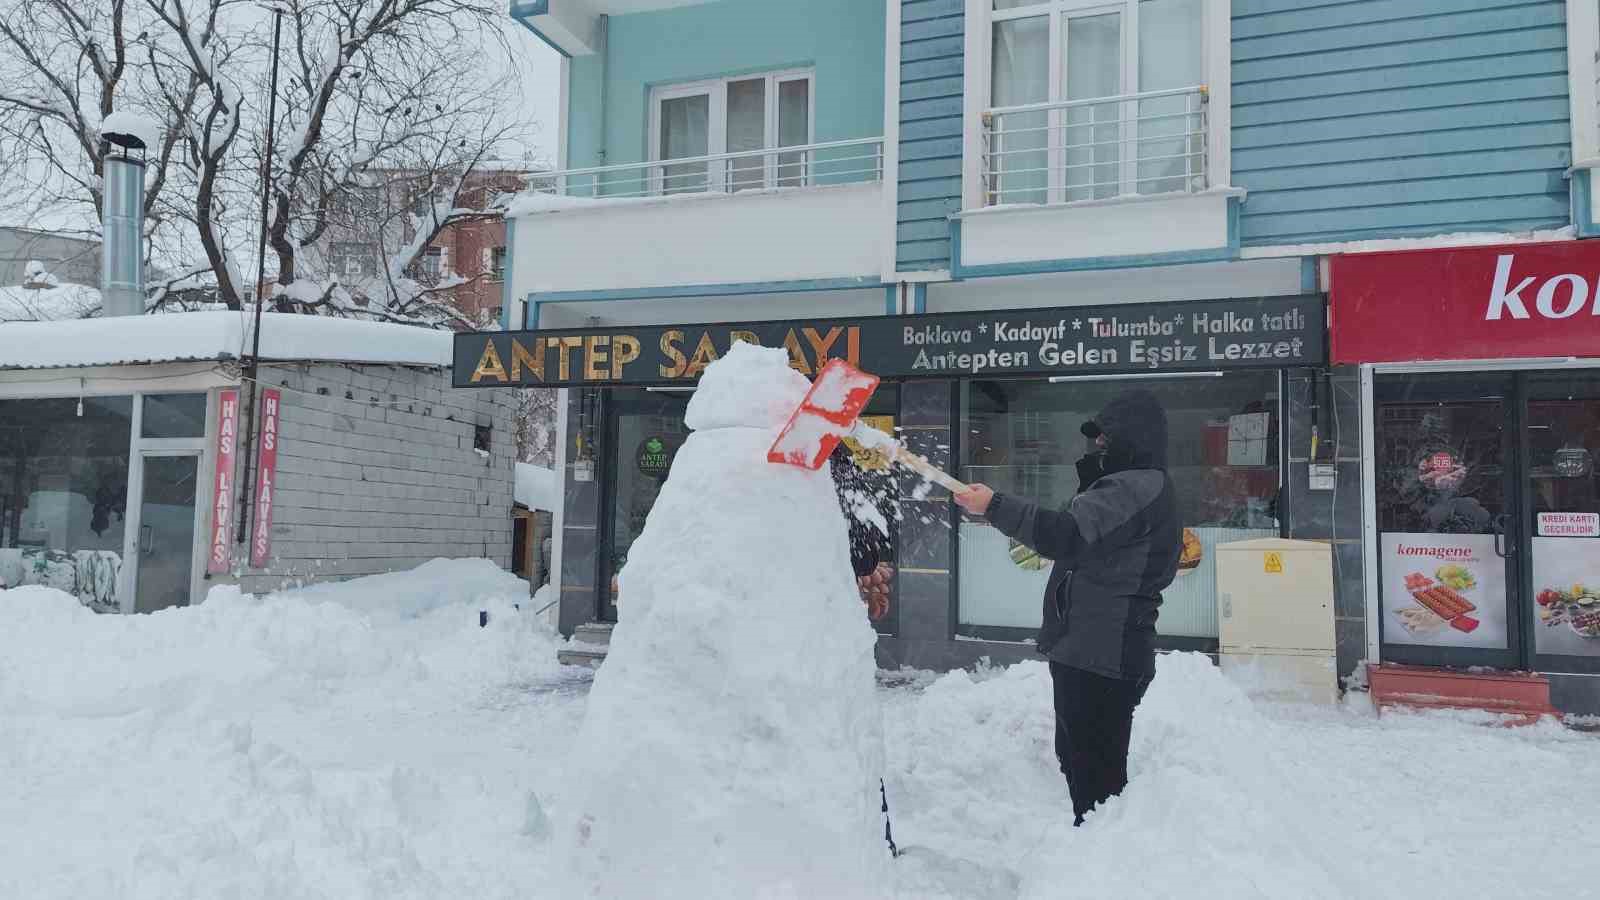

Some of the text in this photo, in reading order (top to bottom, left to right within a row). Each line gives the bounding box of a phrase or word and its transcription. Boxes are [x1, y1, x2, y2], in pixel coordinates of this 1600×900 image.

[1485, 254, 1600, 320] ko
[903, 325, 972, 345] Baklava
[994, 319, 1066, 345] Kadayıf
[1192, 311, 1254, 334] Halka
[471, 334, 641, 382] ANTEP
[911, 336, 1304, 374] Antepten Gelen Eşsiz Lezzet
[220, 400, 234, 454] HAS
[265, 398, 276, 450] HAS
[1397, 543, 1472, 559] komagene
